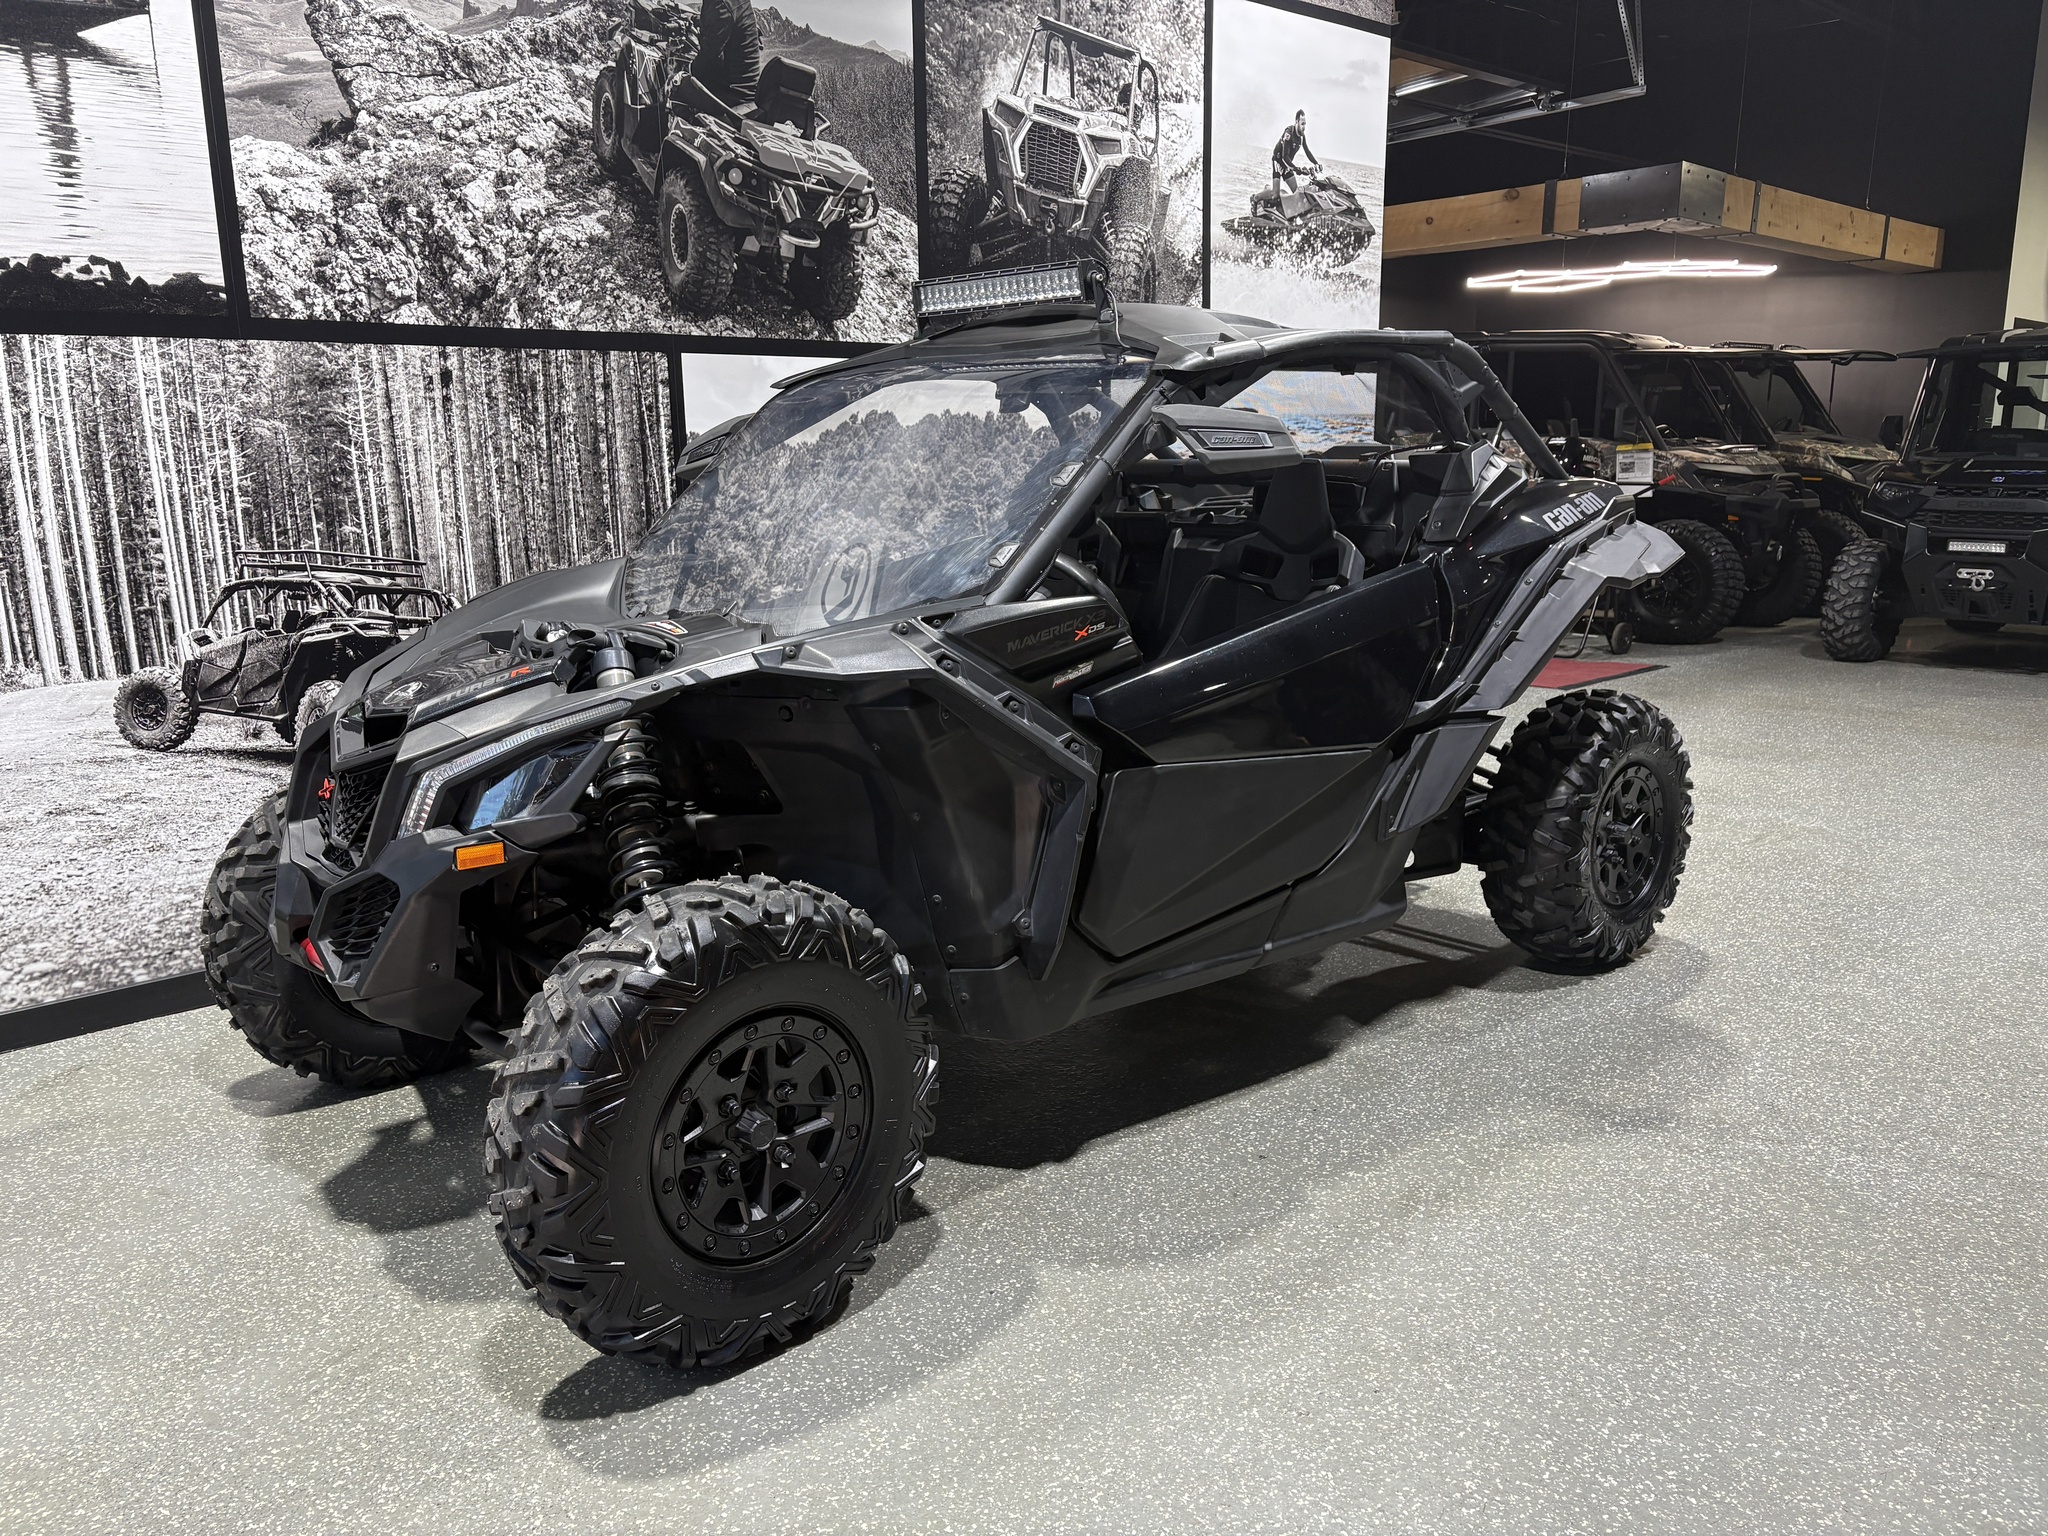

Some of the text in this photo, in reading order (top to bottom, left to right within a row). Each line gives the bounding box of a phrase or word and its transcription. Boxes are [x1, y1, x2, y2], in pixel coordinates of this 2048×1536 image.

[1956, 500, 2027, 510] POLARIS
[1006, 608, 1107, 653] MAVERICK X3
[445, 672, 511, 701] TURBO
